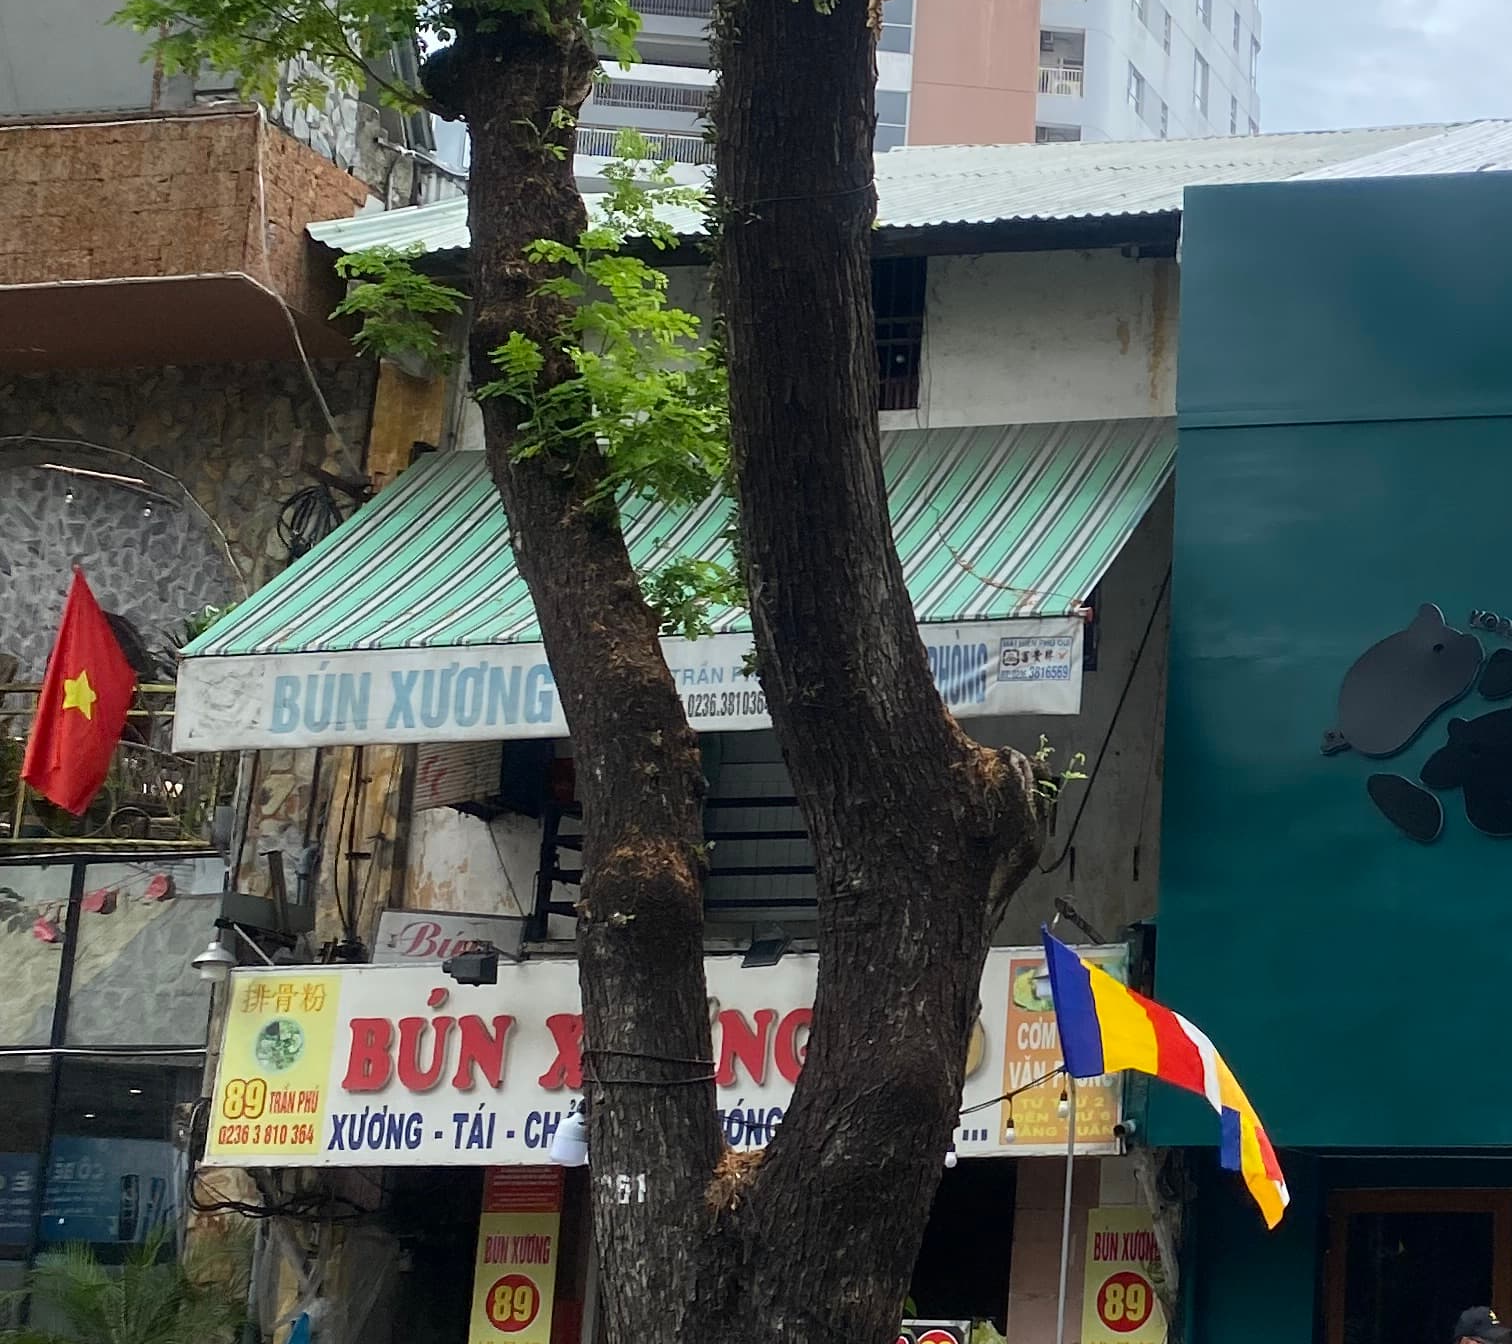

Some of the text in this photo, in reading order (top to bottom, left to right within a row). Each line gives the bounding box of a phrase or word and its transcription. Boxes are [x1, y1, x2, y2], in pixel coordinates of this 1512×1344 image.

[271, 660, 554, 734] BÚN XƯƠNG
[687, 690, 768, 717] 0236.381036
[241, 983, 327, 1013] 排骨粉
[342, 987, 514, 1091] BÚN
[1017, 1016, 1058, 1051] CƠM
[223, 1077, 266, 1119] 89
[218, 1123, 314, 1145] 0236 3 810 364
[327, 1105, 423, 1151] XƯƠNG
[452, 1103, 496, 1150] TÁI
[492, 1284, 534, 1323] 89
[1104, 1282, 1146, 1322] 89
